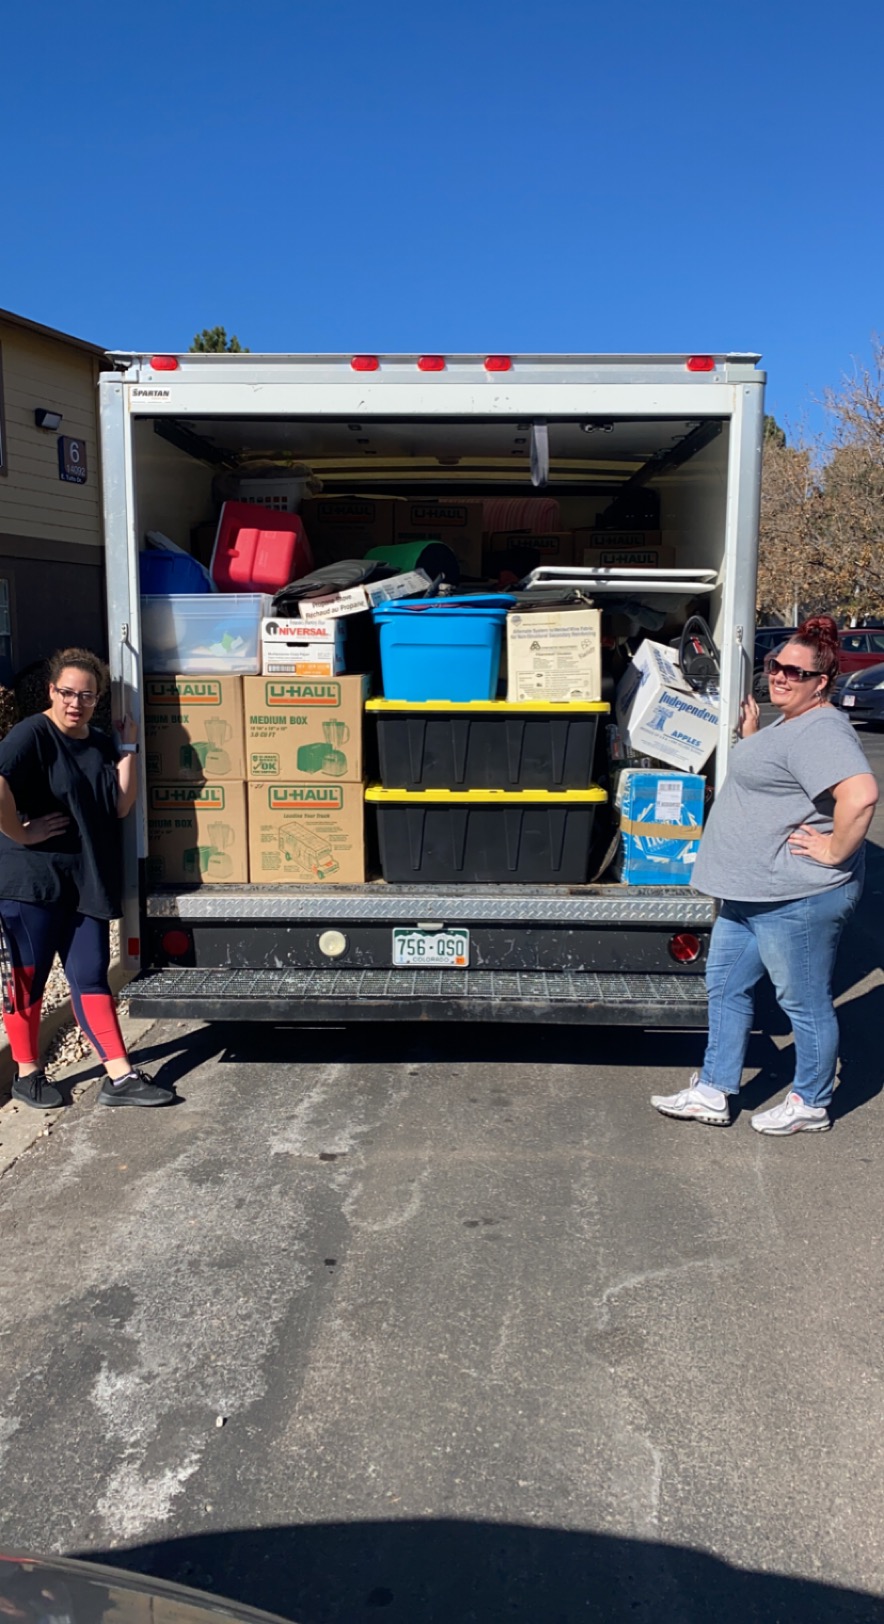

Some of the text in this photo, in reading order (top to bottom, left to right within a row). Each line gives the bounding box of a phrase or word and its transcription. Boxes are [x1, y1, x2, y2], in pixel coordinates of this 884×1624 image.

[132, 388, 170, 397] SPARTAN
[69, 441, 80, 463] 6
[415, 509, 464, 518] U-HAUL
[604, 554, 654, 563] U-HAUL
[151, 684, 217, 695] U-HAUL
[270, 686, 336, 697] U-HAUL
[171, 714, 189, 723] BOX
[250, 715, 308, 725] MEDIUM BOX
[671, 730, 702, 747] APPLES
[155, 789, 220, 801] U-HAUL
[273, 789, 338, 801] U-HAUL
[175, 819, 192, 828] BOX
